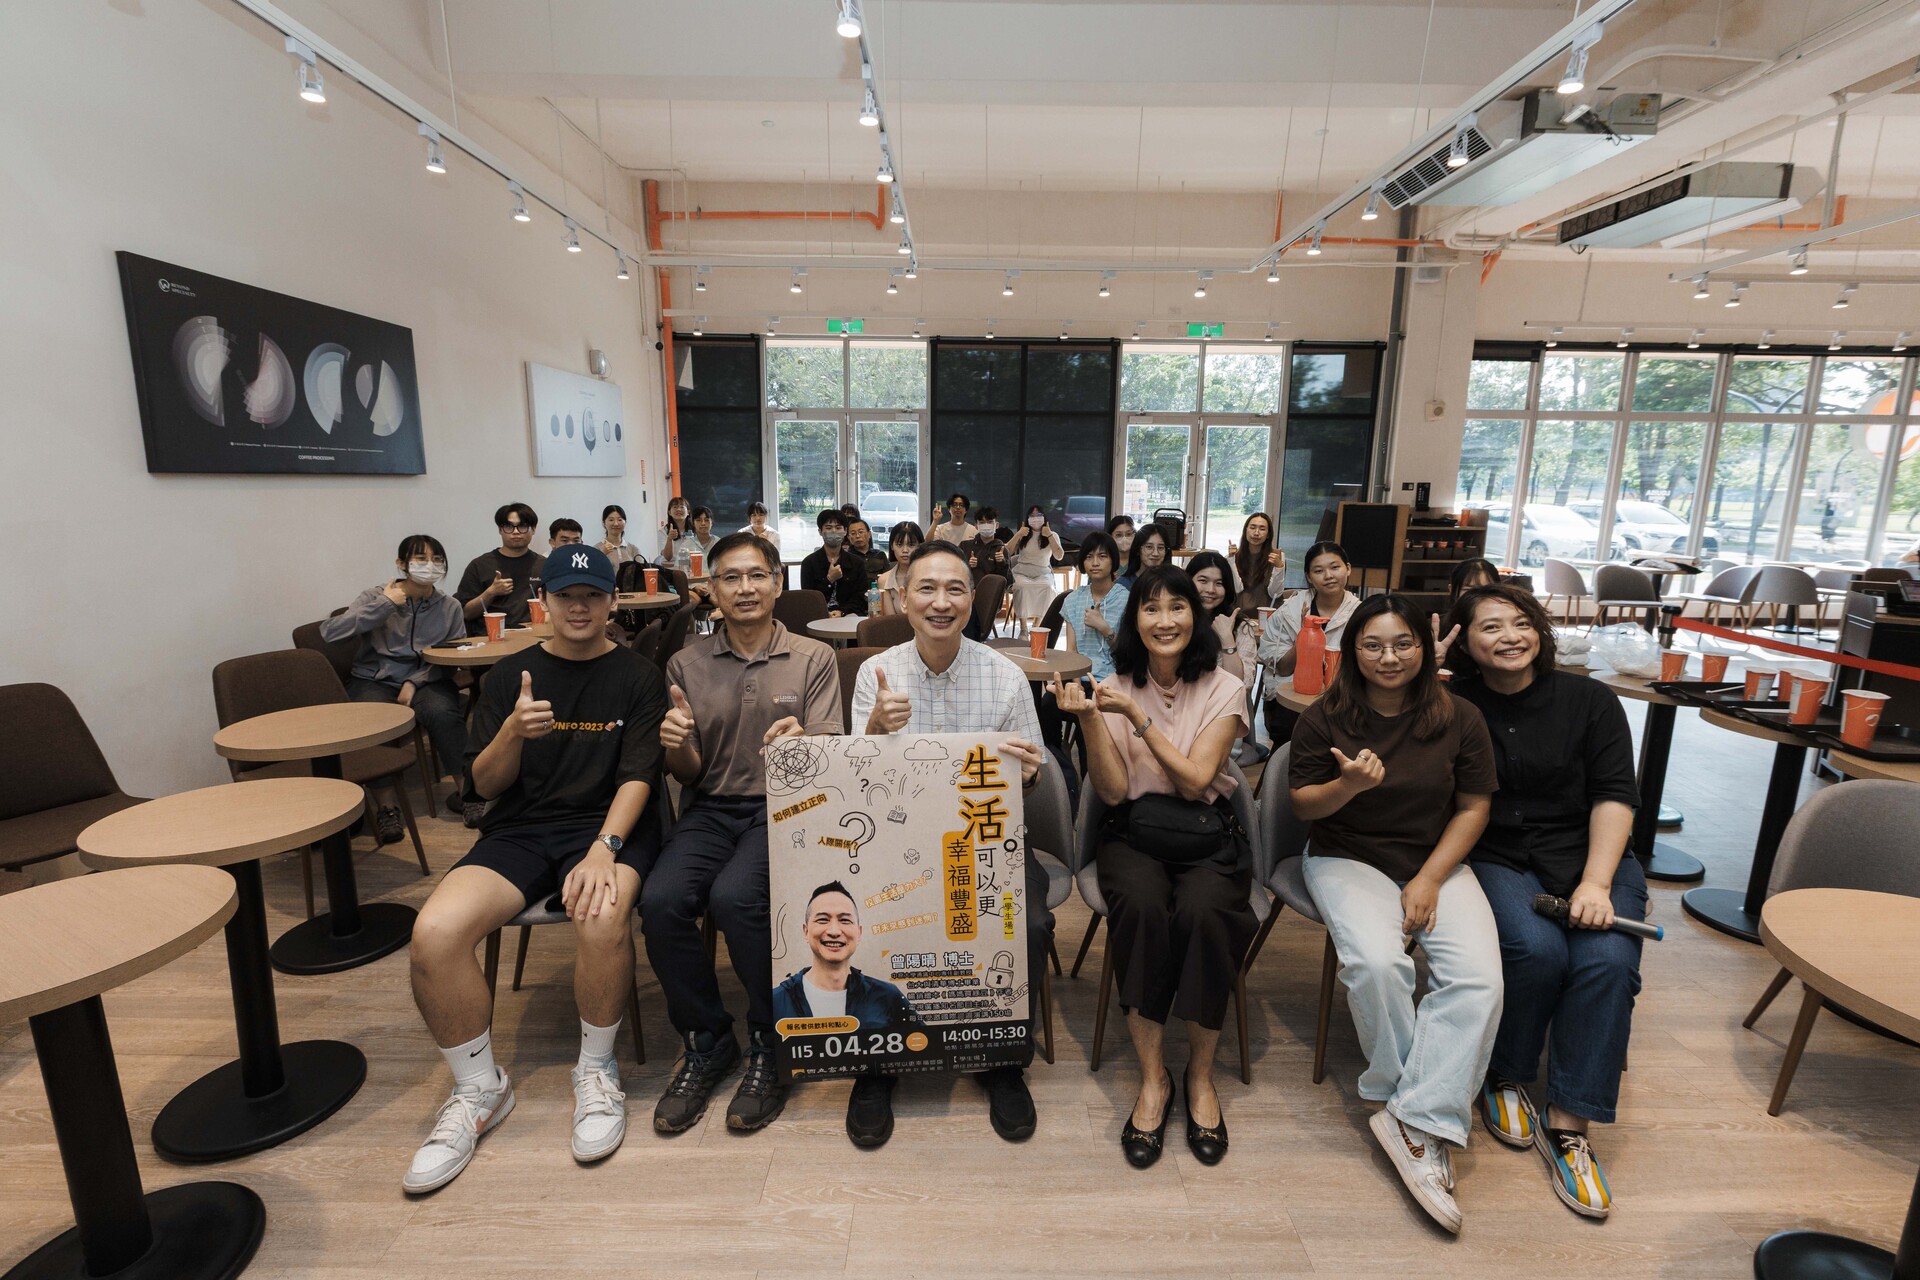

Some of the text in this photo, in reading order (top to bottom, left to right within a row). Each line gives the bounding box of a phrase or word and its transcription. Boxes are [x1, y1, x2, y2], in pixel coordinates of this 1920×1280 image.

[571, 552, 589, 569] NY
[578, 722, 604, 731] 2023
[958, 745, 1007, 842] 生活
[772, 793, 828, 823] 如何建立正向
[946, 838, 973, 935] 幸福豐盛
[975, 847, 999, 917] 可以更
[891, 951, 974, 970] 曾陽晴 博士
[786, 1021, 849, 1031] 報名者供飲料和點心
[942, 1025, 1027, 1043] 14:00-15:30
